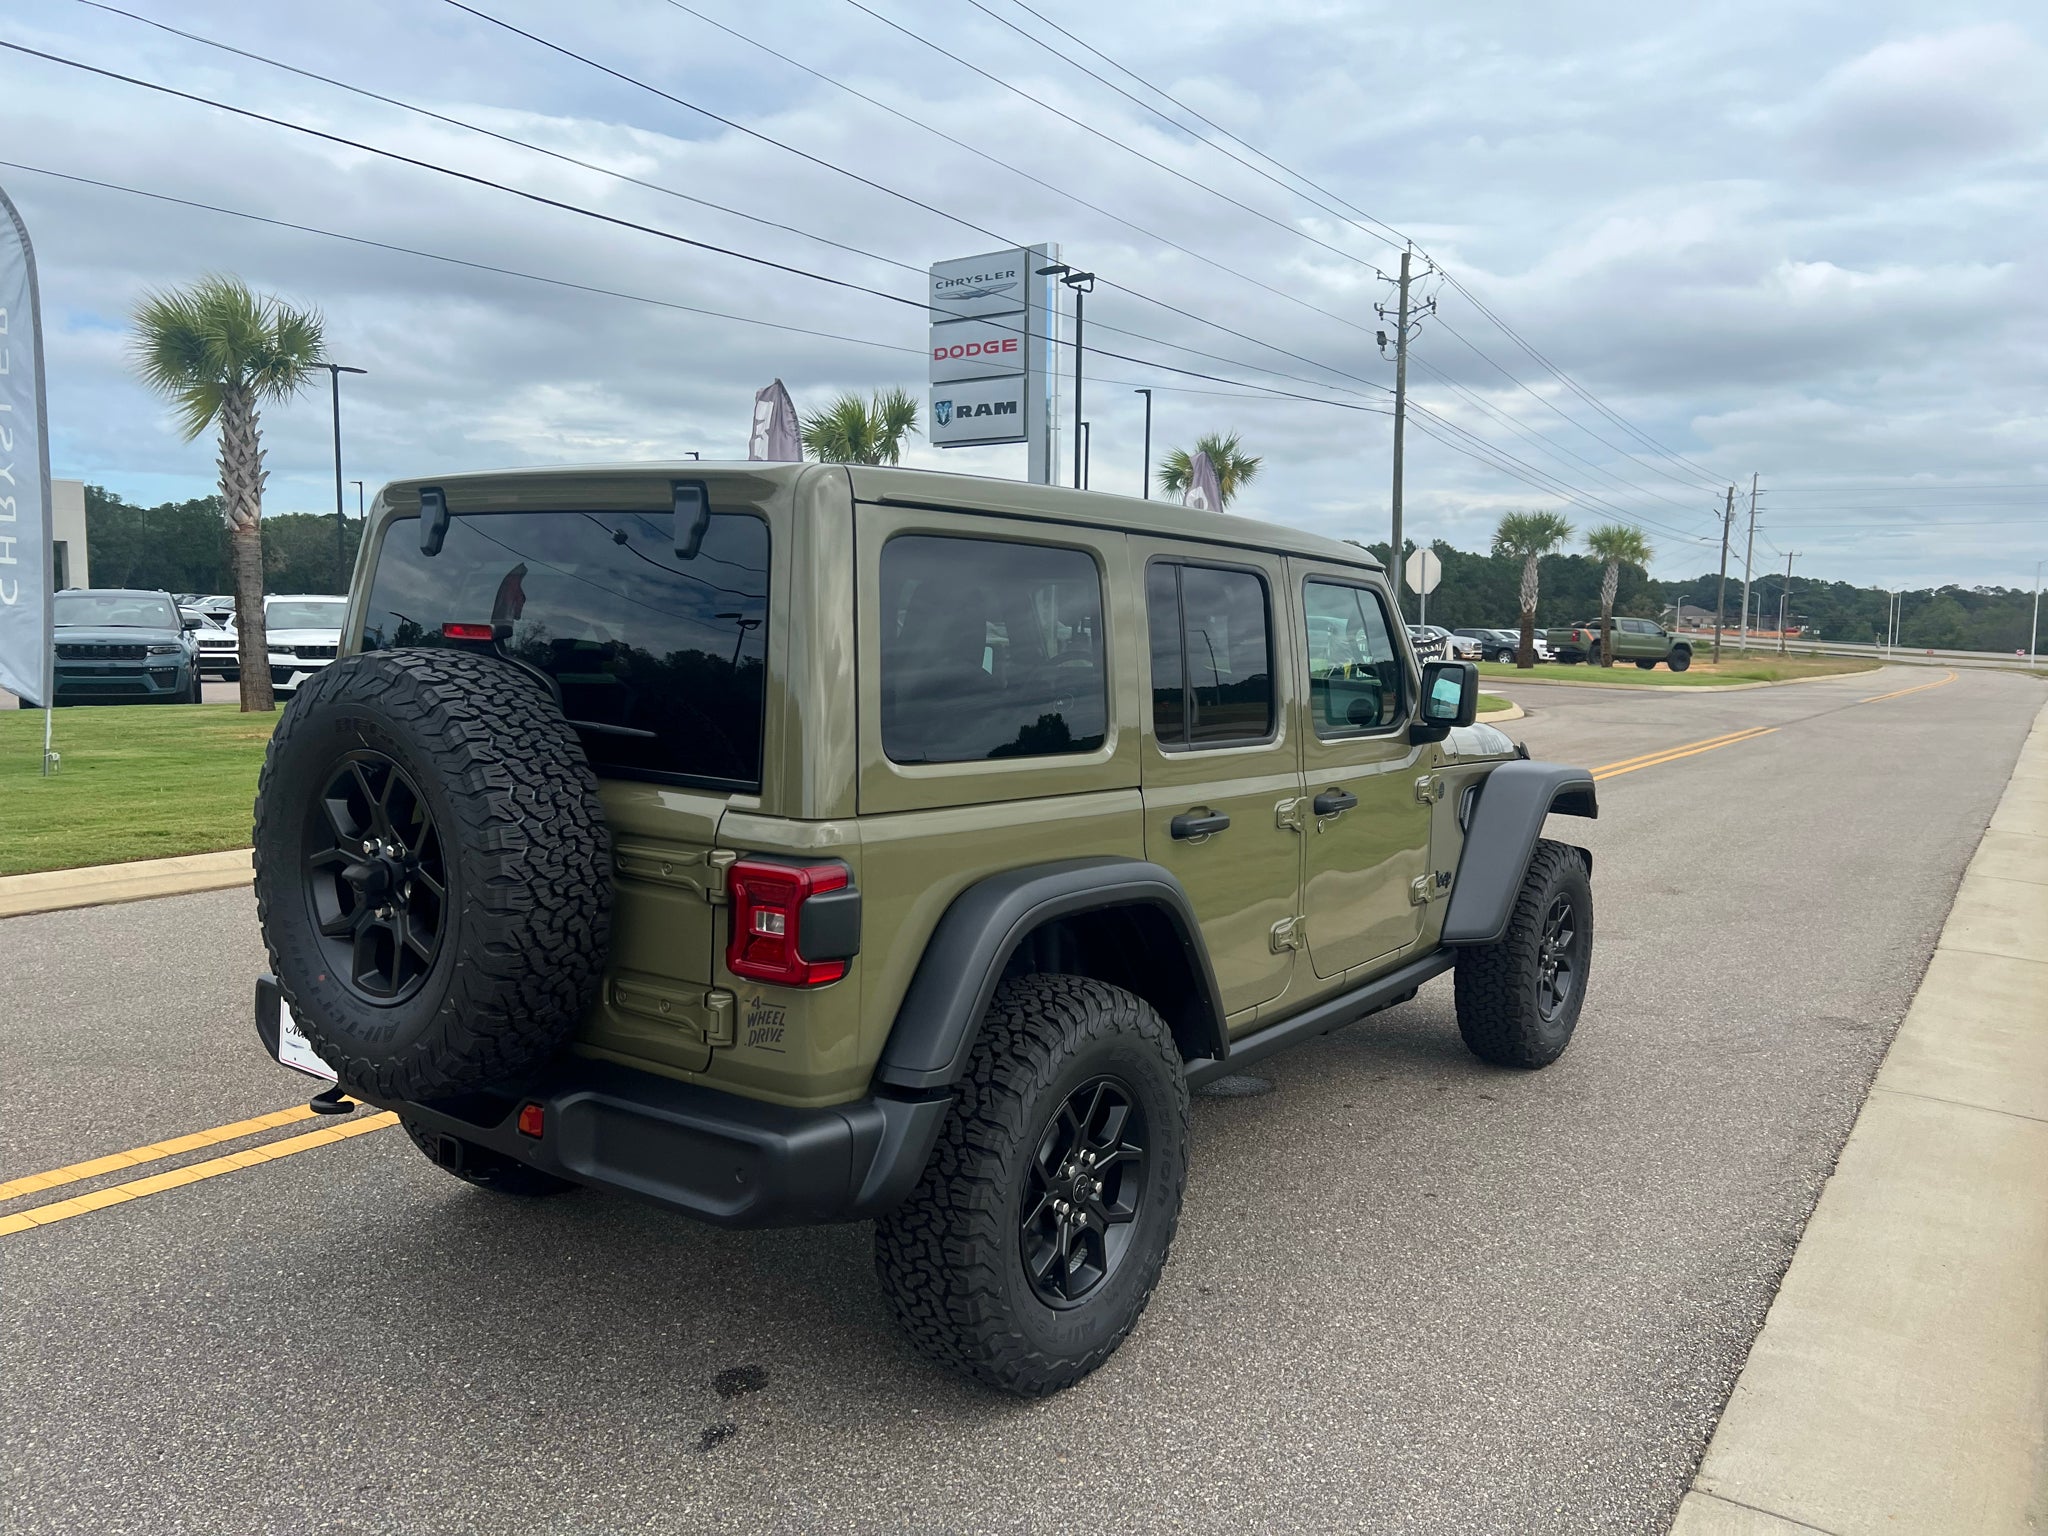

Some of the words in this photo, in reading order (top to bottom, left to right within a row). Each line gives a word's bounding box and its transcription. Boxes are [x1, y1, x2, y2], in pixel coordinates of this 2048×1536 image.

[935, 270, 1016, 290] CHRYSLER
[934, 338, 1018, 361] DODGE
[956, 400, 1018, 419] RAM
[751, 996, 760, 1009] 4
[747, 1010, 785, 1028] WHEEL
[748, 1027, 785, 1047] DRIVE
